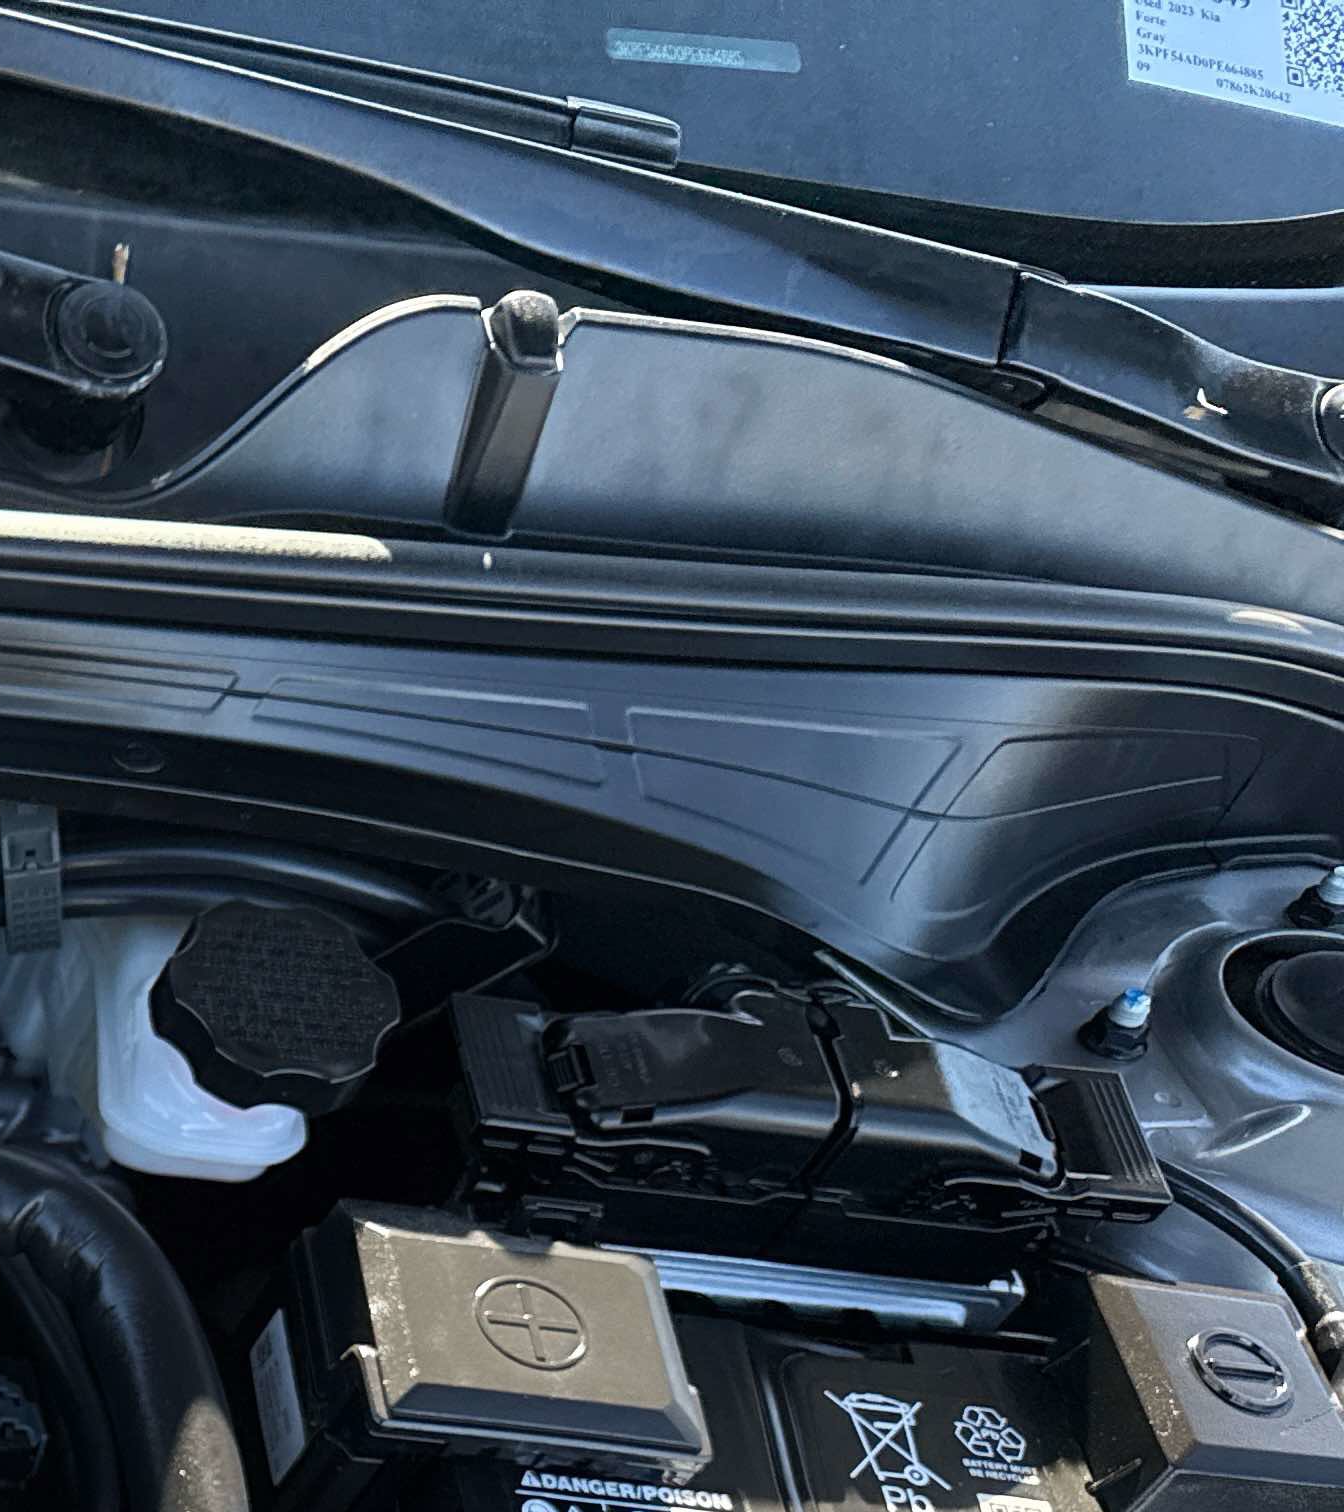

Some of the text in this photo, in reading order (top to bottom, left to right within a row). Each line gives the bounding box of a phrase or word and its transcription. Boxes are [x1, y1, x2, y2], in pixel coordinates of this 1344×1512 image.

[1136, 10, 1167, 26] Forte
[1168, 2, 1195, 16] 2023
[1201, 8, 1221, 22] Kia
[1136, 27, 1165, 44] Gray
[1137, 60, 1150, 72] 09
[985, 1469, 1041, 1486] RECYCL
[539, 1473, 734, 1511] DANGER/POISON
